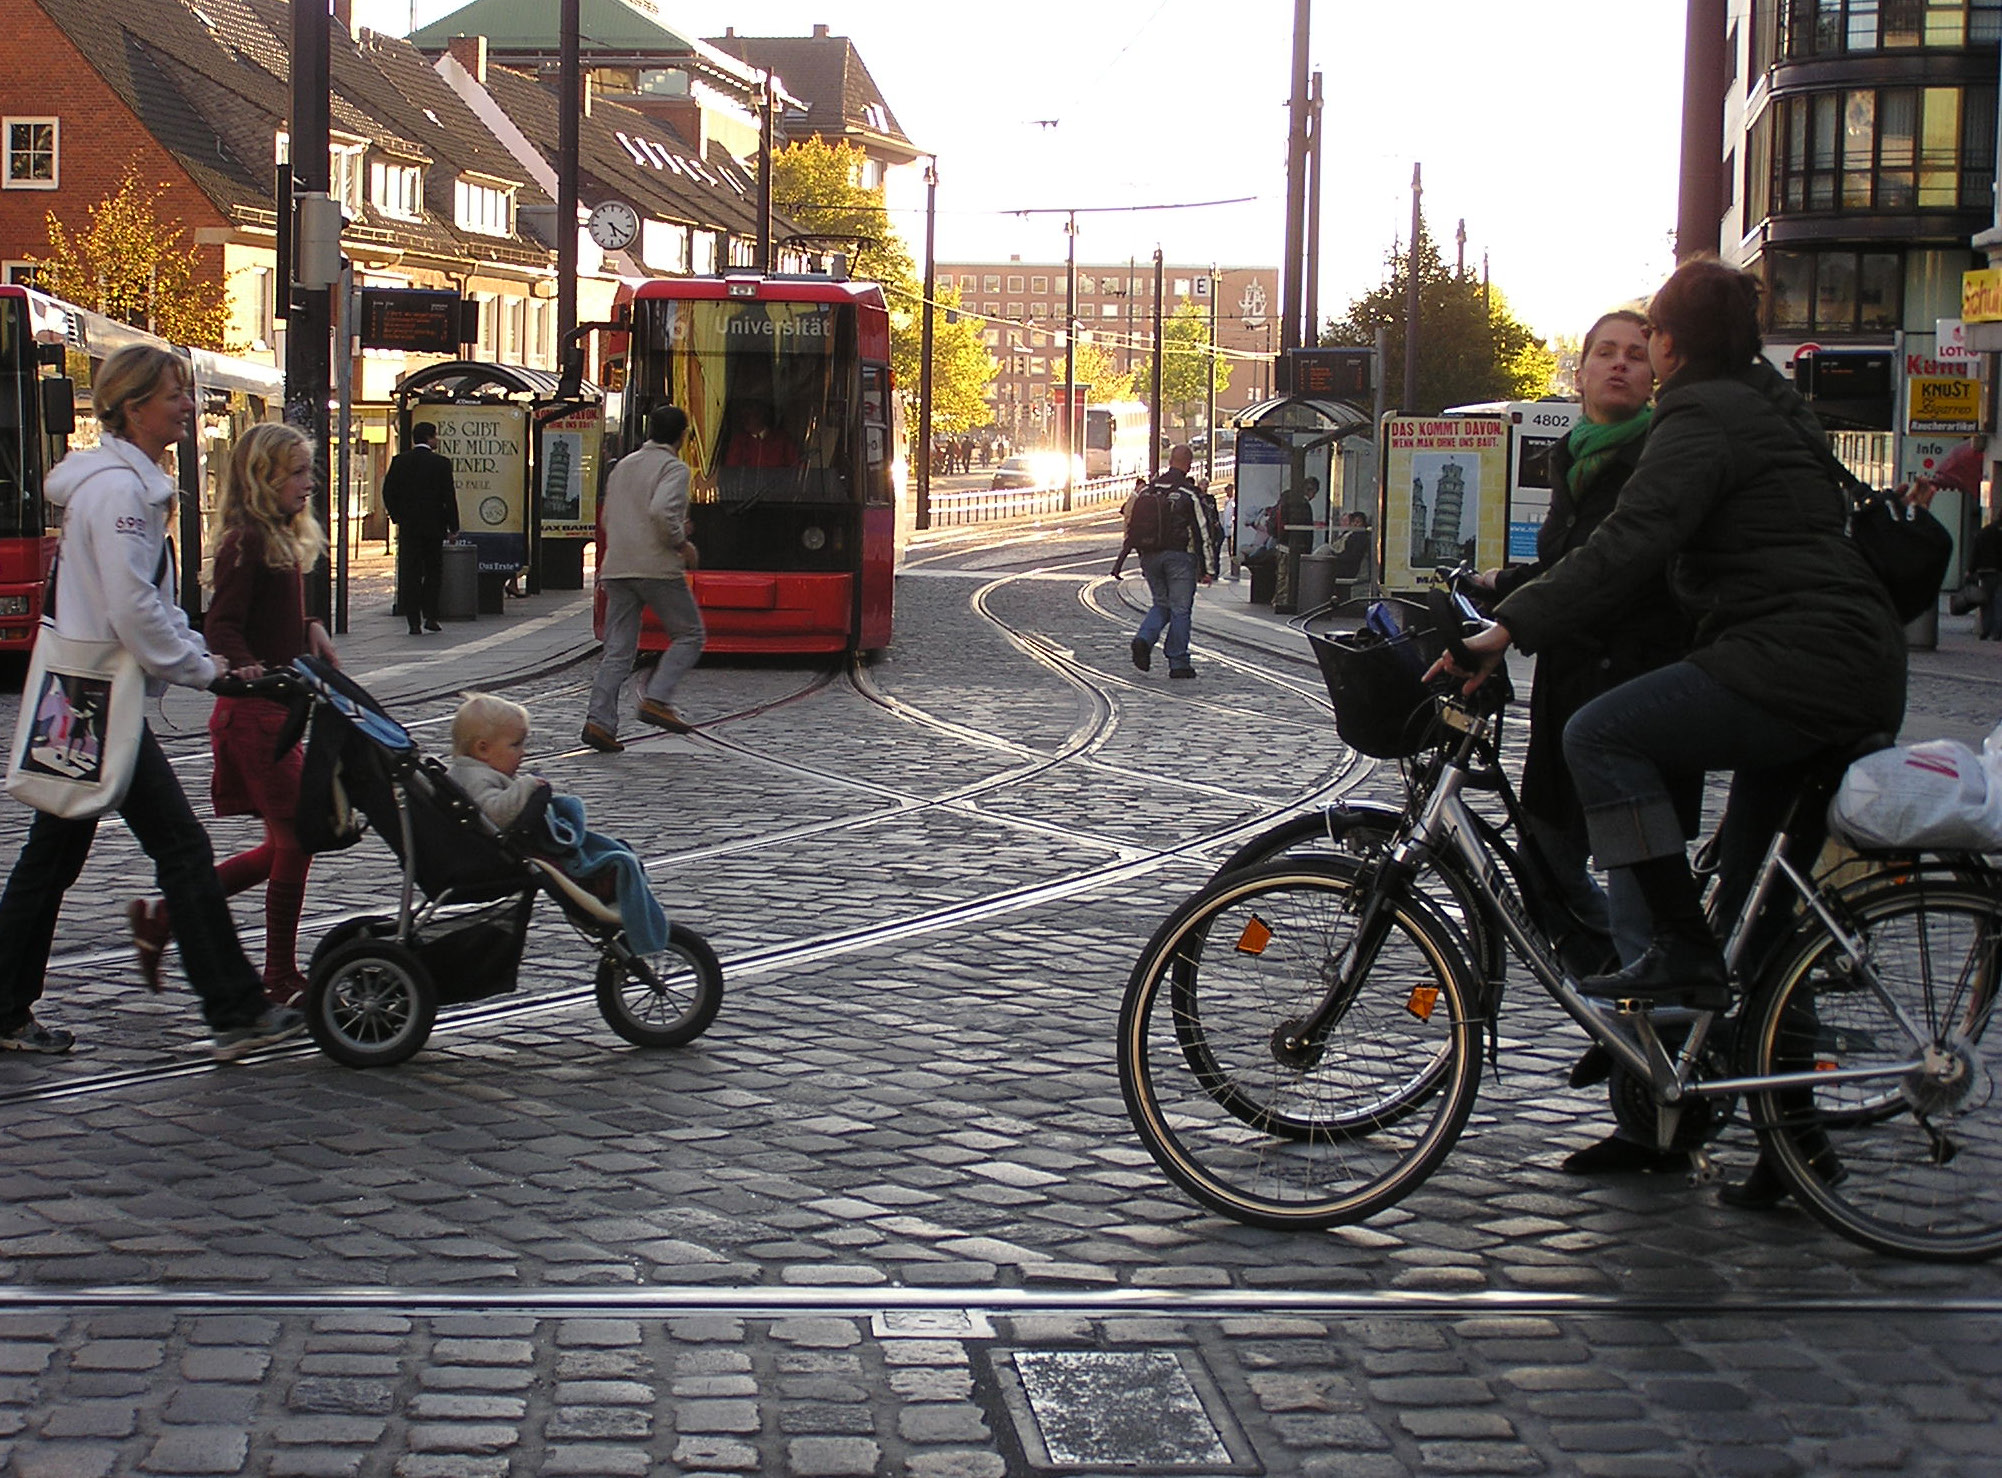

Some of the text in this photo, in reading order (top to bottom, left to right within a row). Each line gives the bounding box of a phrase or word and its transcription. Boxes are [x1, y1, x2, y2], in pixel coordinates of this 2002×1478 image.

[1197, 278, 1207, 294] E
[716, 315, 831, 337] Universität
[1939, 346, 1978, 357] LOT
[1532, 414, 1570, 428] 4802
[437, 421, 500, 437] ES GIBT
[1392, 422, 1504, 437] DAS KOMMT DAVON.
[438, 437, 519, 456] INE MÜDEN
[1392, 438, 1414, 448] WENN
[1417, 438, 1435, 448] MAN
[1438, 437, 1456, 448] OHNE
[1459, 437, 1474, 447] UNS
[1917, 443, 1943, 455] Info
